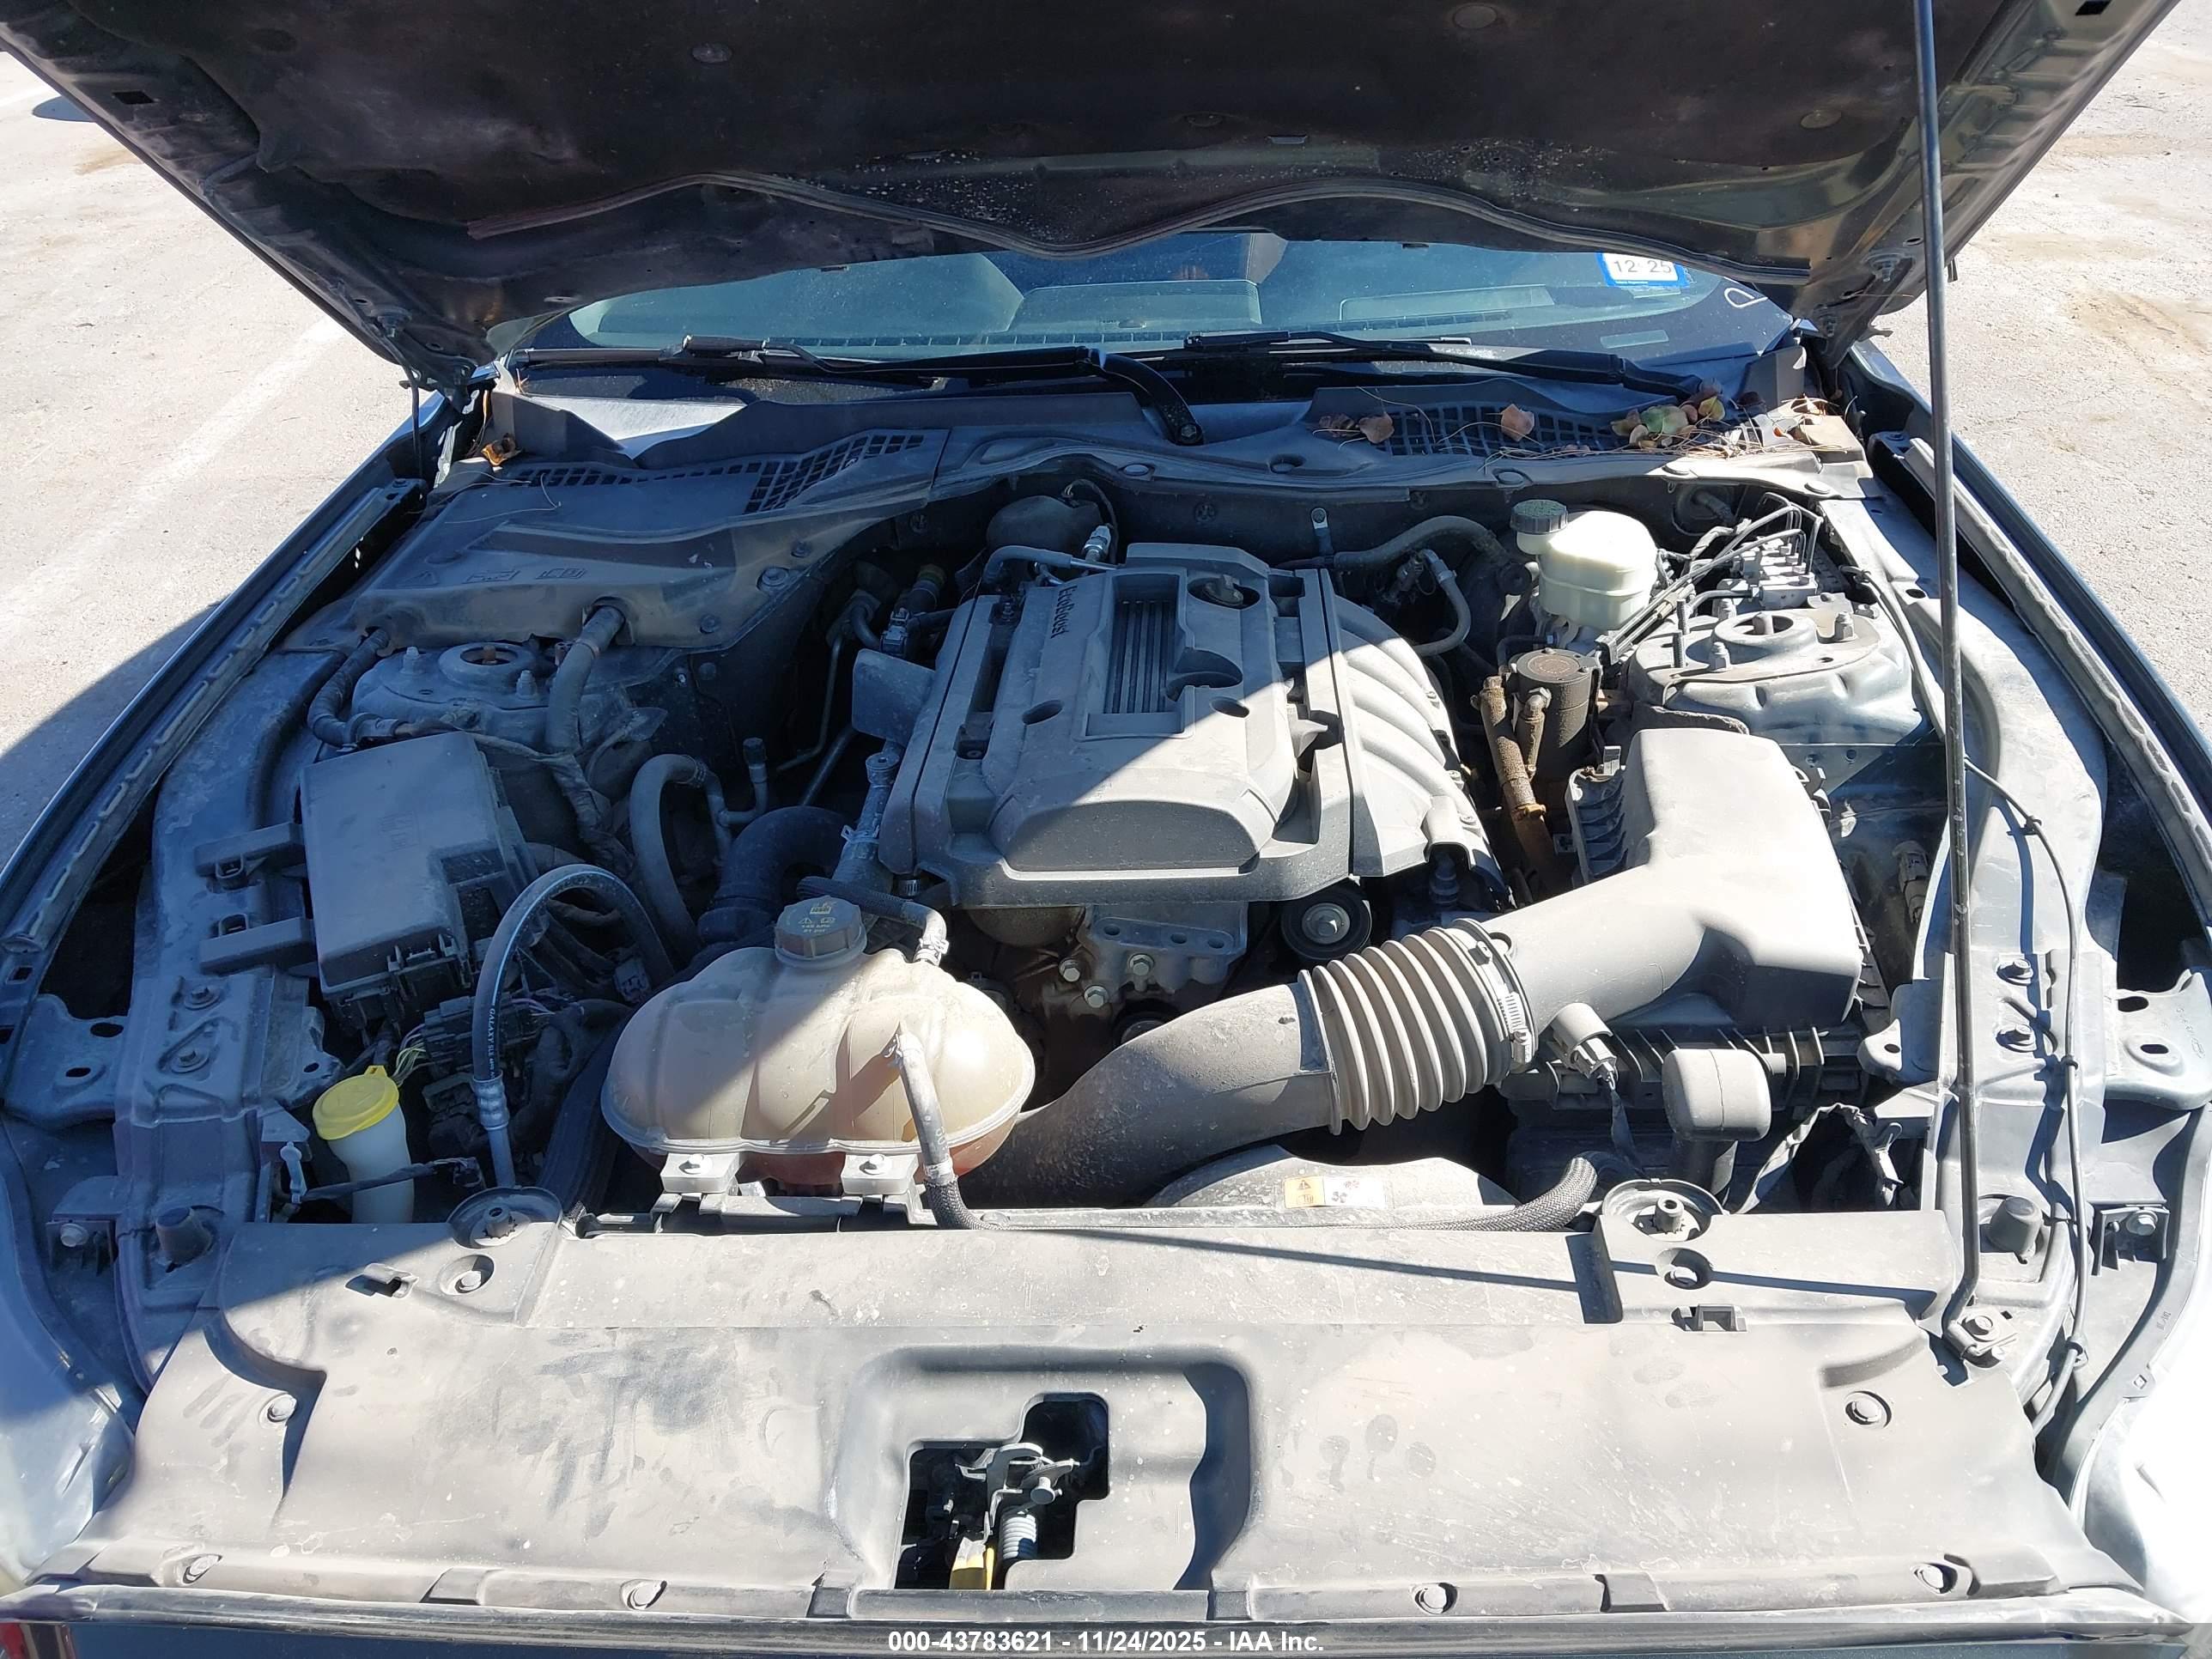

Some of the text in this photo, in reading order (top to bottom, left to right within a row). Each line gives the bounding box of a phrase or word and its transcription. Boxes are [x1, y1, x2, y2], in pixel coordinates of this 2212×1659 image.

[1613, 259, 1673, 274] 12 25
[1051, 586, 1078, 639] EcoBoost
